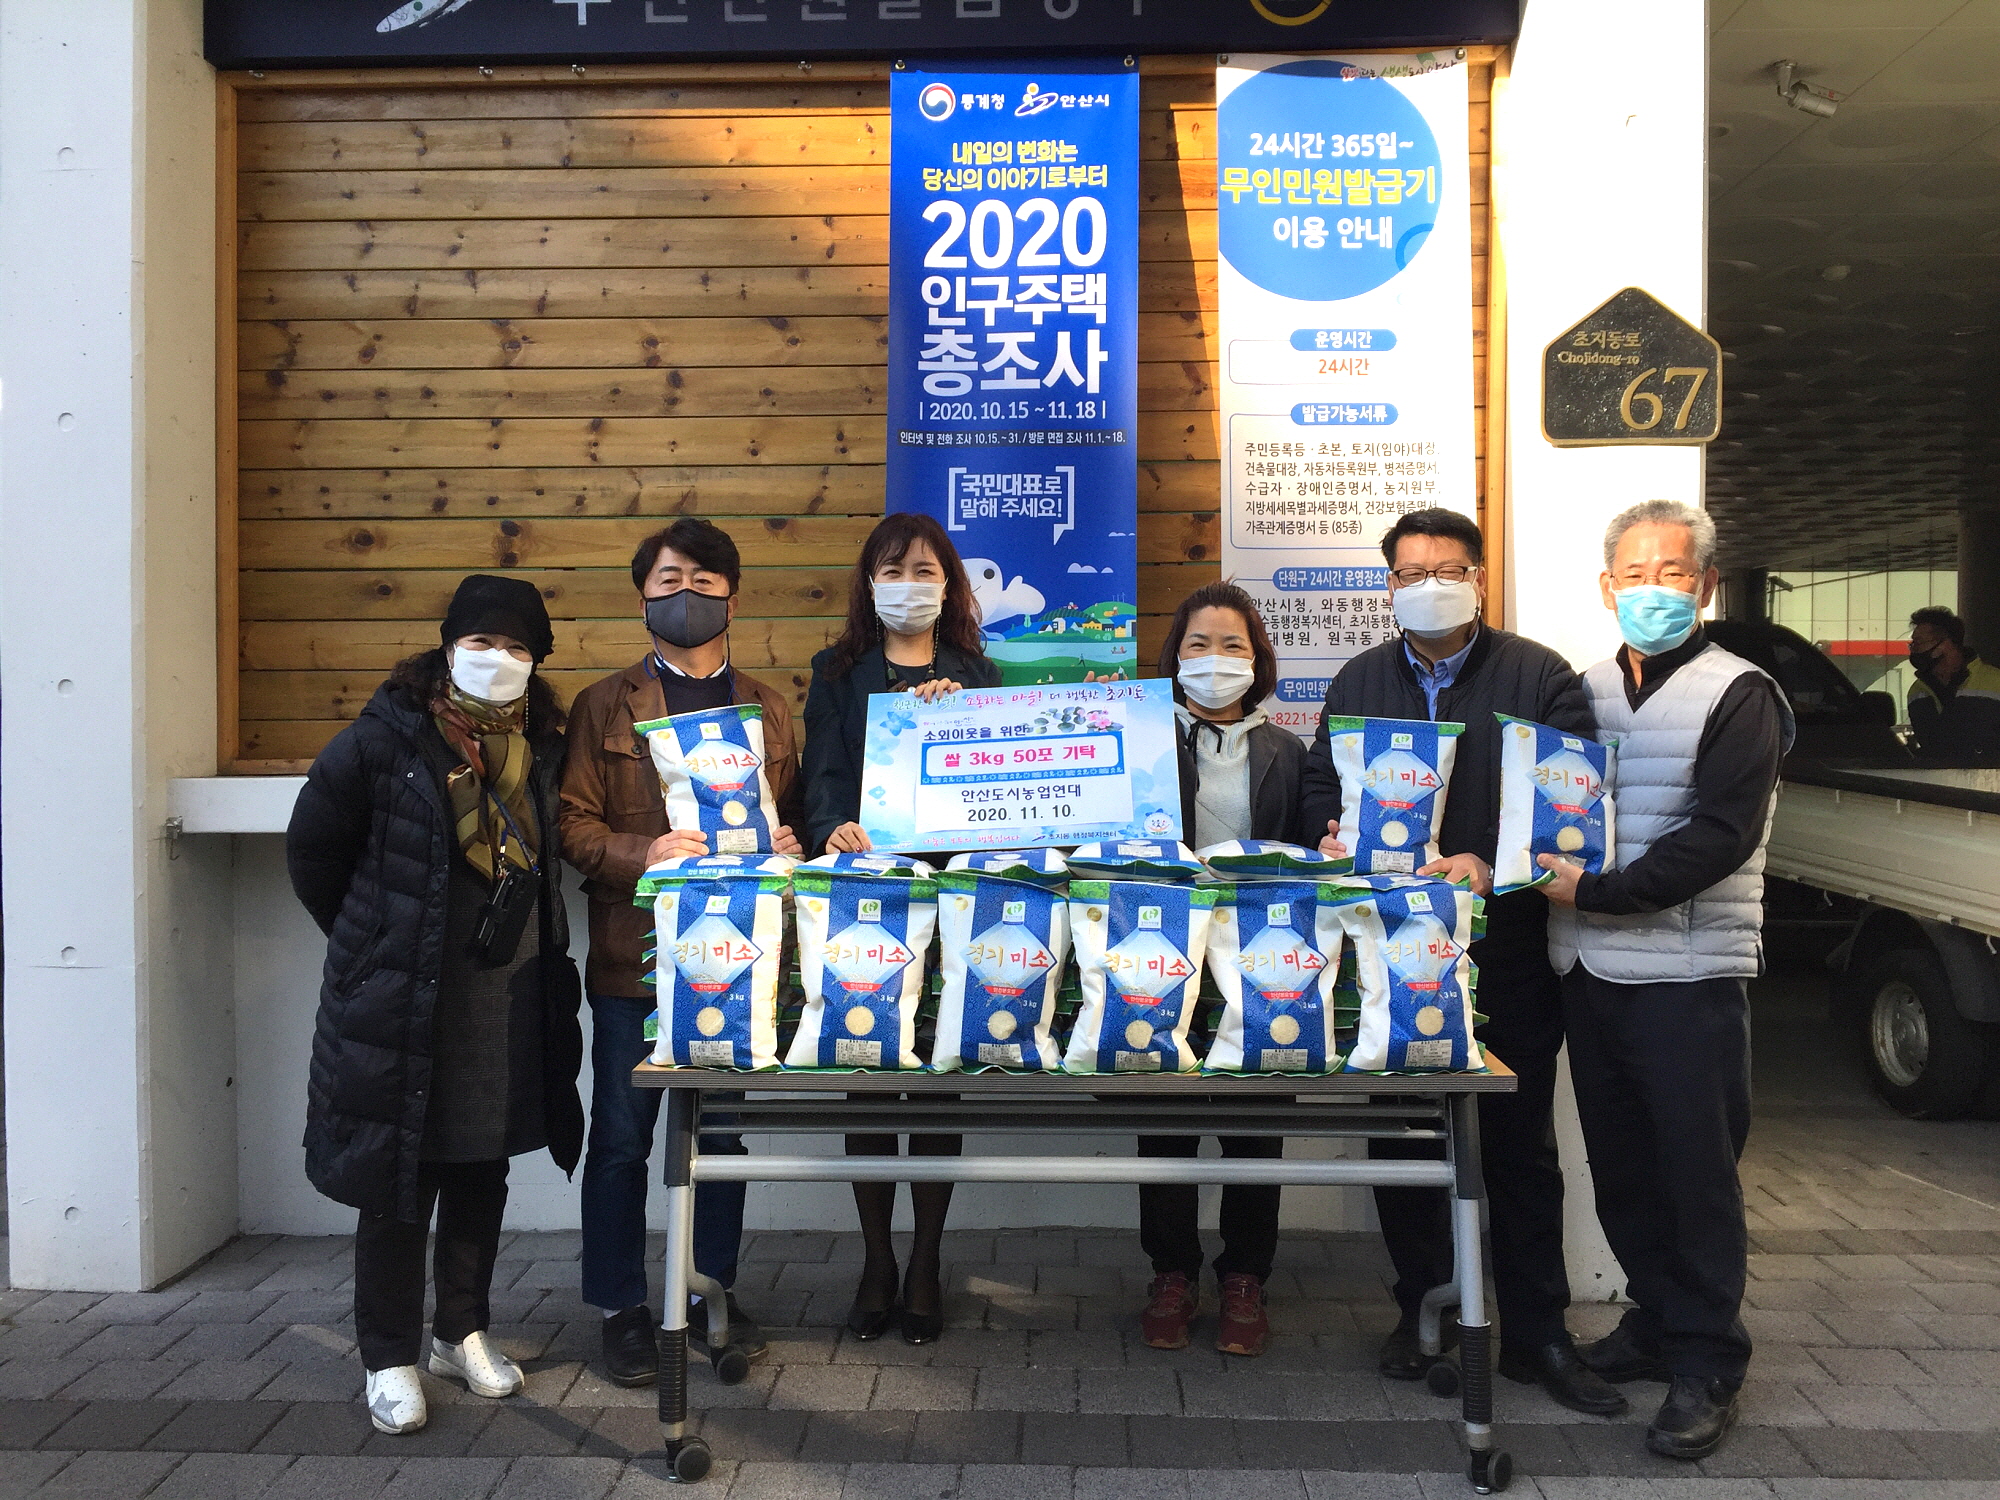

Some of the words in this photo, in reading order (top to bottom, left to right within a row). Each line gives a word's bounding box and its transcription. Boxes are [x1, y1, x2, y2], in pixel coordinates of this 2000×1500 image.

[961, 93, 1005, 110] 통계청
[1060, 94, 1110, 108] 안산시
[952, 141, 1012, 165] 내일의
[1017, 140, 1078, 163] 변화는
[1250, 132, 1325, 158] 24시간
[1331, 132, 1414, 159] 365일~
[922, 168, 983, 191] 당신의
[987, 164, 1108, 190] 이야기로부터
[1220, 166, 1436, 204] 무인민원발급기
[921, 196, 1107, 269] 2020
[1273, 216, 1329, 248] 이용
[1337, 216, 1393, 248] 안내
[921, 273, 1106, 326] 인구주택
[1314, 331, 1373, 349] 운영시간
[1573, 330, 1642, 350] 초지동로
[917, 329, 1108, 396] 총조사
[1318, 358, 1370, 376] 24시간
[1558, 350, 1640, 366] Chojidong-ro
[1620, 367, 1709, 430] 67
[1302, 405, 1388, 423] 발급가능서류
[900, 431, 925, 445] 인터넷
[926, 433, 934, 446] 및
[936, 432, 953, 445] 전화
[955, 433, 972, 445] 조사
[1028, 432, 1044, 444] 방문
[1047, 432, 1063, 445] 면접
[1066, 432, 1082, 444] 조사
[1244, 442, 1306, 457] 주민등록등
[1317, 442, 1346, 457] 초본,
[1245, 462, 1301, 477] 건축물대장,
[1303, 462, 1381, 477] 자동차등록원부,
[961, 474, 1062, 496] 국민대표로
[1244, 482, 1282, 496] 수급자
[1296, 481, 1377, 496] 장애인증명서,
[961, 498, 998, 518] 말해
[1001, 497, 1062, 518] 주세요!
[1245, 501, 1362, 516] 지방세세목별과세증명서,
[1245, 520, 1316, 536] 가족관계증명서
[1318, 520, 1329, 535] 등
[1331, 520, 1363, 536] (85종)
[1278, 571, 1308, 588] 단원구
[1310, 571, 1343, 588] 24시간
[1327, 632, 1373, 646] 원곡동
[966, 695, 1003, 709] 소통하는
[1011, 690, 1042, 706] 마을!
[1066, 689, 1099, 702] 행복한
[1106, 684, 1146, 702] 초지동
[1283, 681, 1333, 698] 무인민원
[923, 726, 992, 741] 소외이웃을
[999, 725, 1028, 738] 위한
[722, 753, 757, 769] 미소
[944, 753, 961, 767] 쌀
[969, 751, 1004, 767] 3kg
[1013, 747, 1054, 763] 50포
[1062, 744, 1096, 761] 기탁
[1363, 767, 1394, 788] 경기
[1400, 769, 1437, 788] 미소
[1532, 766, 1569, 788] 경기
[961, 784, 1082, 803] 안산도시농업연대
[967, 808, 1011, 822] 2020.
[1020, 807, 1043, 820] 11.
[1053, 805, 1076, 818] 10.
[673, 940, 707, 964] 경기
[712, 940, 754, 965] 미소
[822, 943, 860, 965] 경기
[867, 944, 907, 965] 미소
[966, 942, 1004, 968] 경기
[1010, 947, 1049, 969] 미소
[1384, 939, 1420, 963] 경기
[1427, 937, 1457, 960] 미소
[1147, 954, 1188, 978] 미소
[1237, 950, 1276, 973] 경기
[1282, 949, 1322, 971] 미소
